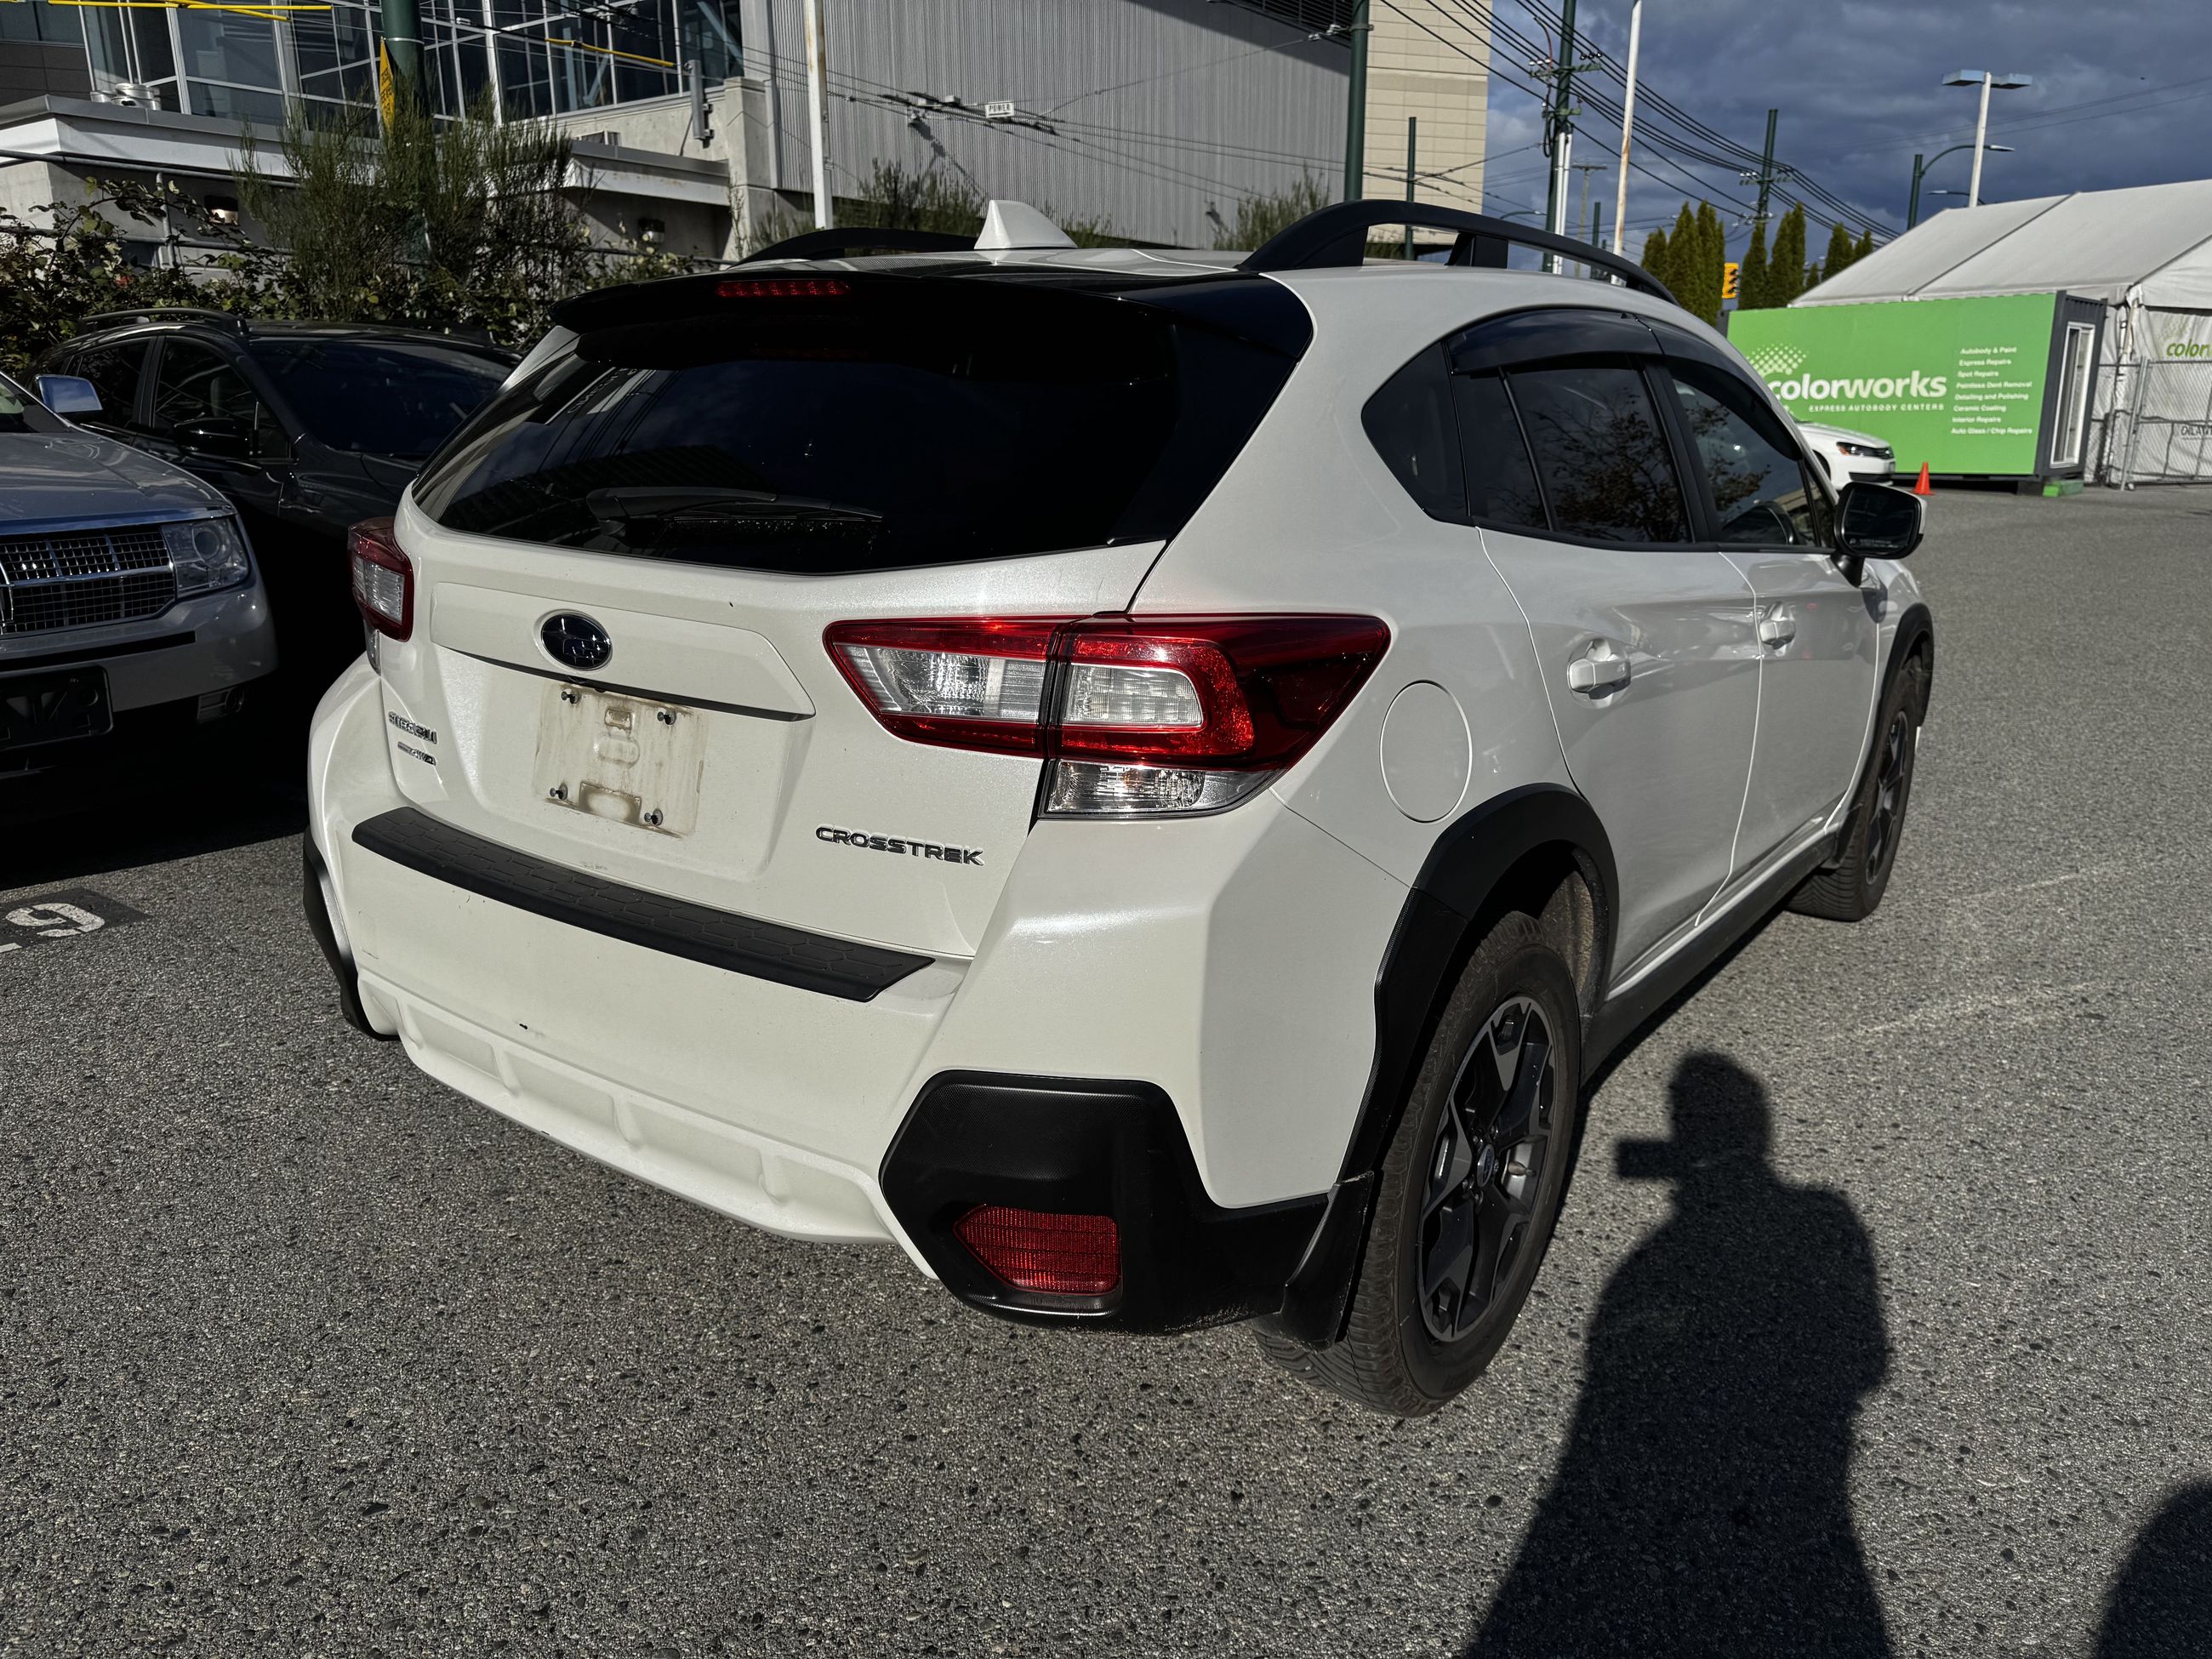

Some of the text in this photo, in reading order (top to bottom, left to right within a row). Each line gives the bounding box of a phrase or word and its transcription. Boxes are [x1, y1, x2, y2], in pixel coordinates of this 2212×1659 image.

[1954, 393, 1983, 402] Detailing
[1998, 392, 2029, 401] Polishing
[1808, 404, 1846, 413] EXPRESS
[1900, 402, 1945, 412] CENTERS
[1981, 404, 2006, 413] Coating
[1975, 415, 2002, 424] Repairs
[2007, 426, 2033, 436] Repairs
[815, 823, 985, 866] CROSSTREK
